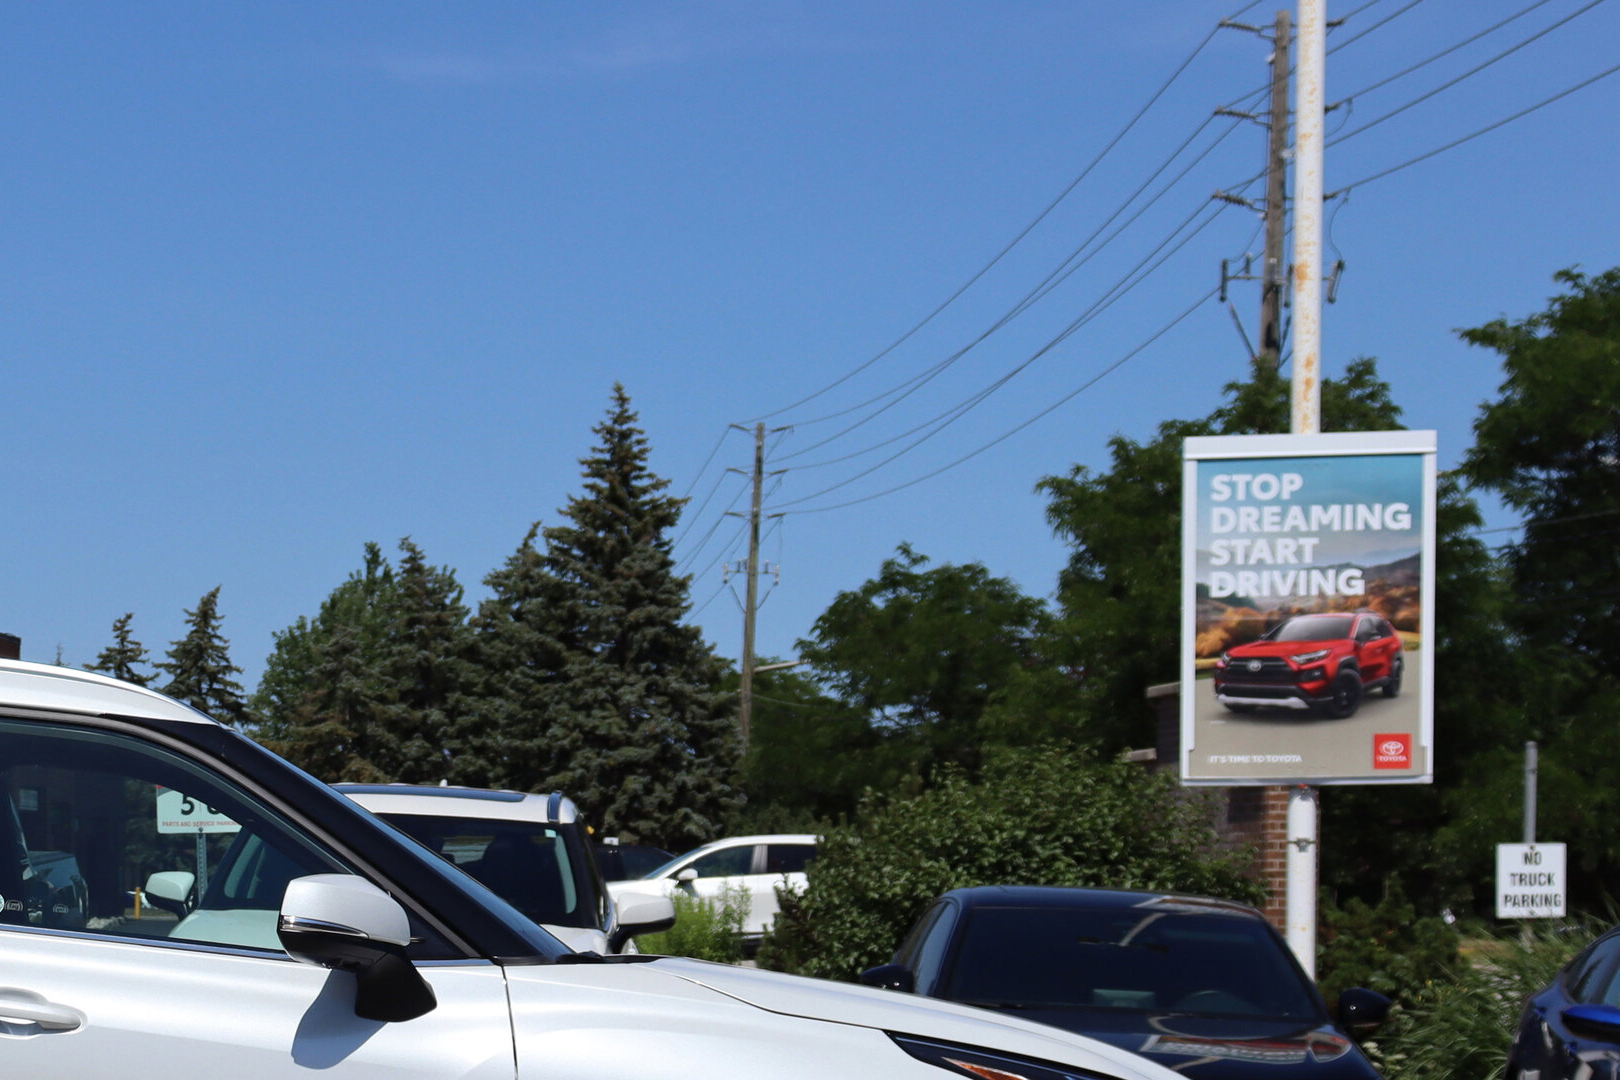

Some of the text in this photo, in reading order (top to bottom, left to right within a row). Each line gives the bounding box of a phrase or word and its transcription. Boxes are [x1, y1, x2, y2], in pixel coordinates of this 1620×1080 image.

[1210, 473, 1303, 501] STOP
[1211, 502, 1412, 534] DREAMING
[1210, 537, 1319, 566] START
[1210, 568, 1366, 598] DRIVING
[1228, 755, 1250, 763] TIME
[1252, 755, 1265, 763] TO
[1267, 754, 1302, 763] TOYOTA
[1524, 851, 1542, 865] NO
[1510, 872, 1555, 886] TRUCK
[1504, 893, 1562, 908] PARKING
